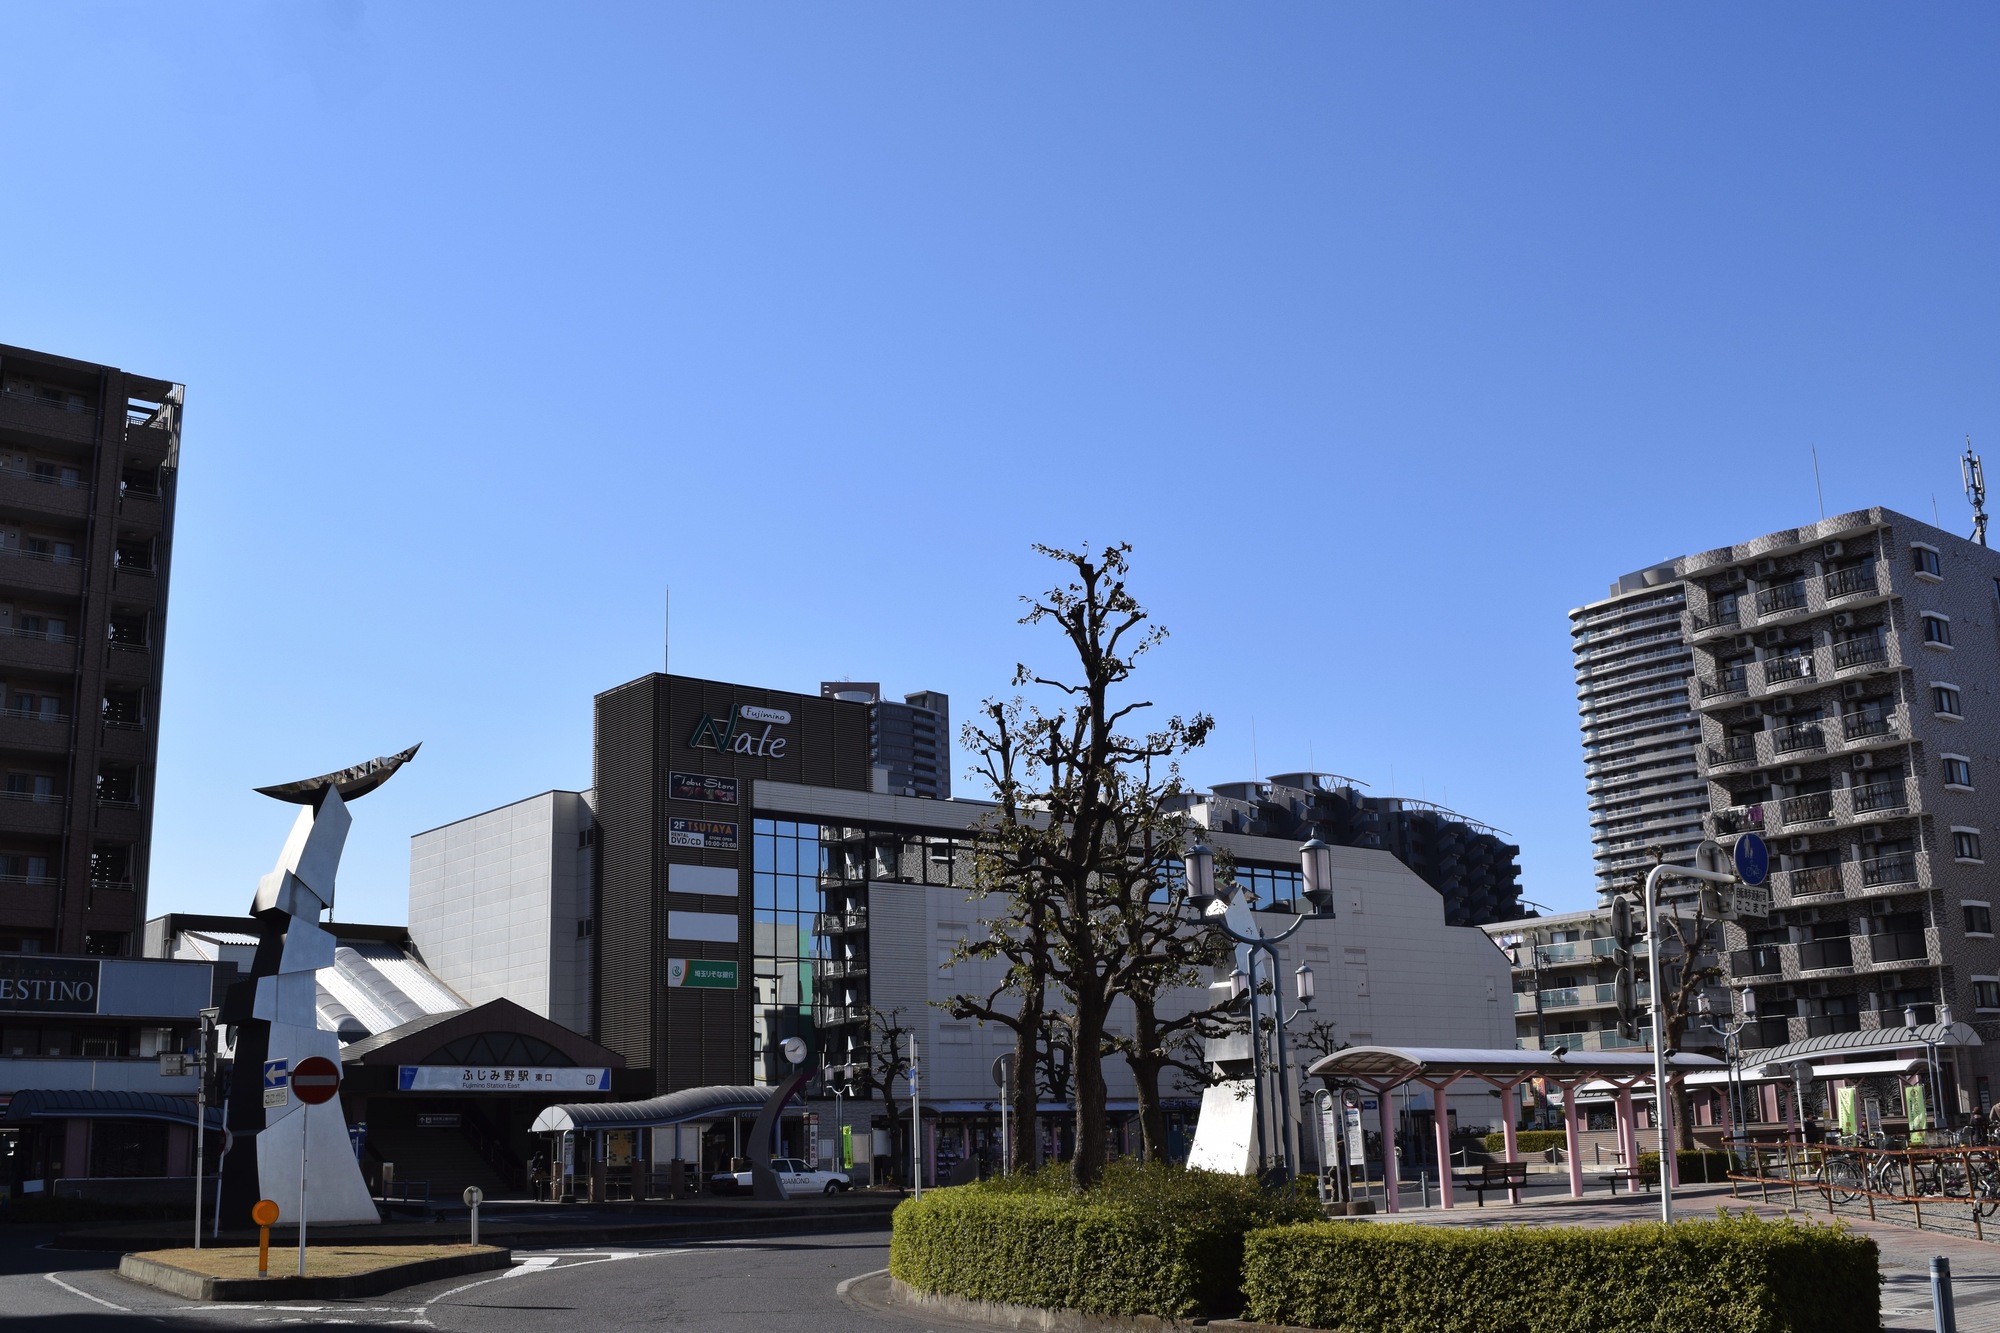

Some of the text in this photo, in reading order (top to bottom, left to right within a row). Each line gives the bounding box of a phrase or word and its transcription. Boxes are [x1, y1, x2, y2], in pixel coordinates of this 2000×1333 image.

[746, 707, 785, 721] Fujimino
[690, 703, 787, 759] Nale
[674, 774, 735, 790] Tobu Store
[673, 821, 733, 835] 2F TSUTAYA
[671, 836, 702, 845] DVD/CD
[705, 840, 737, 849] 10:00-25:00
[1736, 900, 1767, 915] ここまで
[694, 969, 734, 980] 埼玉りそな銀行
[0, 979, 94, 1002] ESTINO
[462, 1069, 553, 1083] ふじみ野駅 東口
[265, 1092, 286, 1104] ここから
